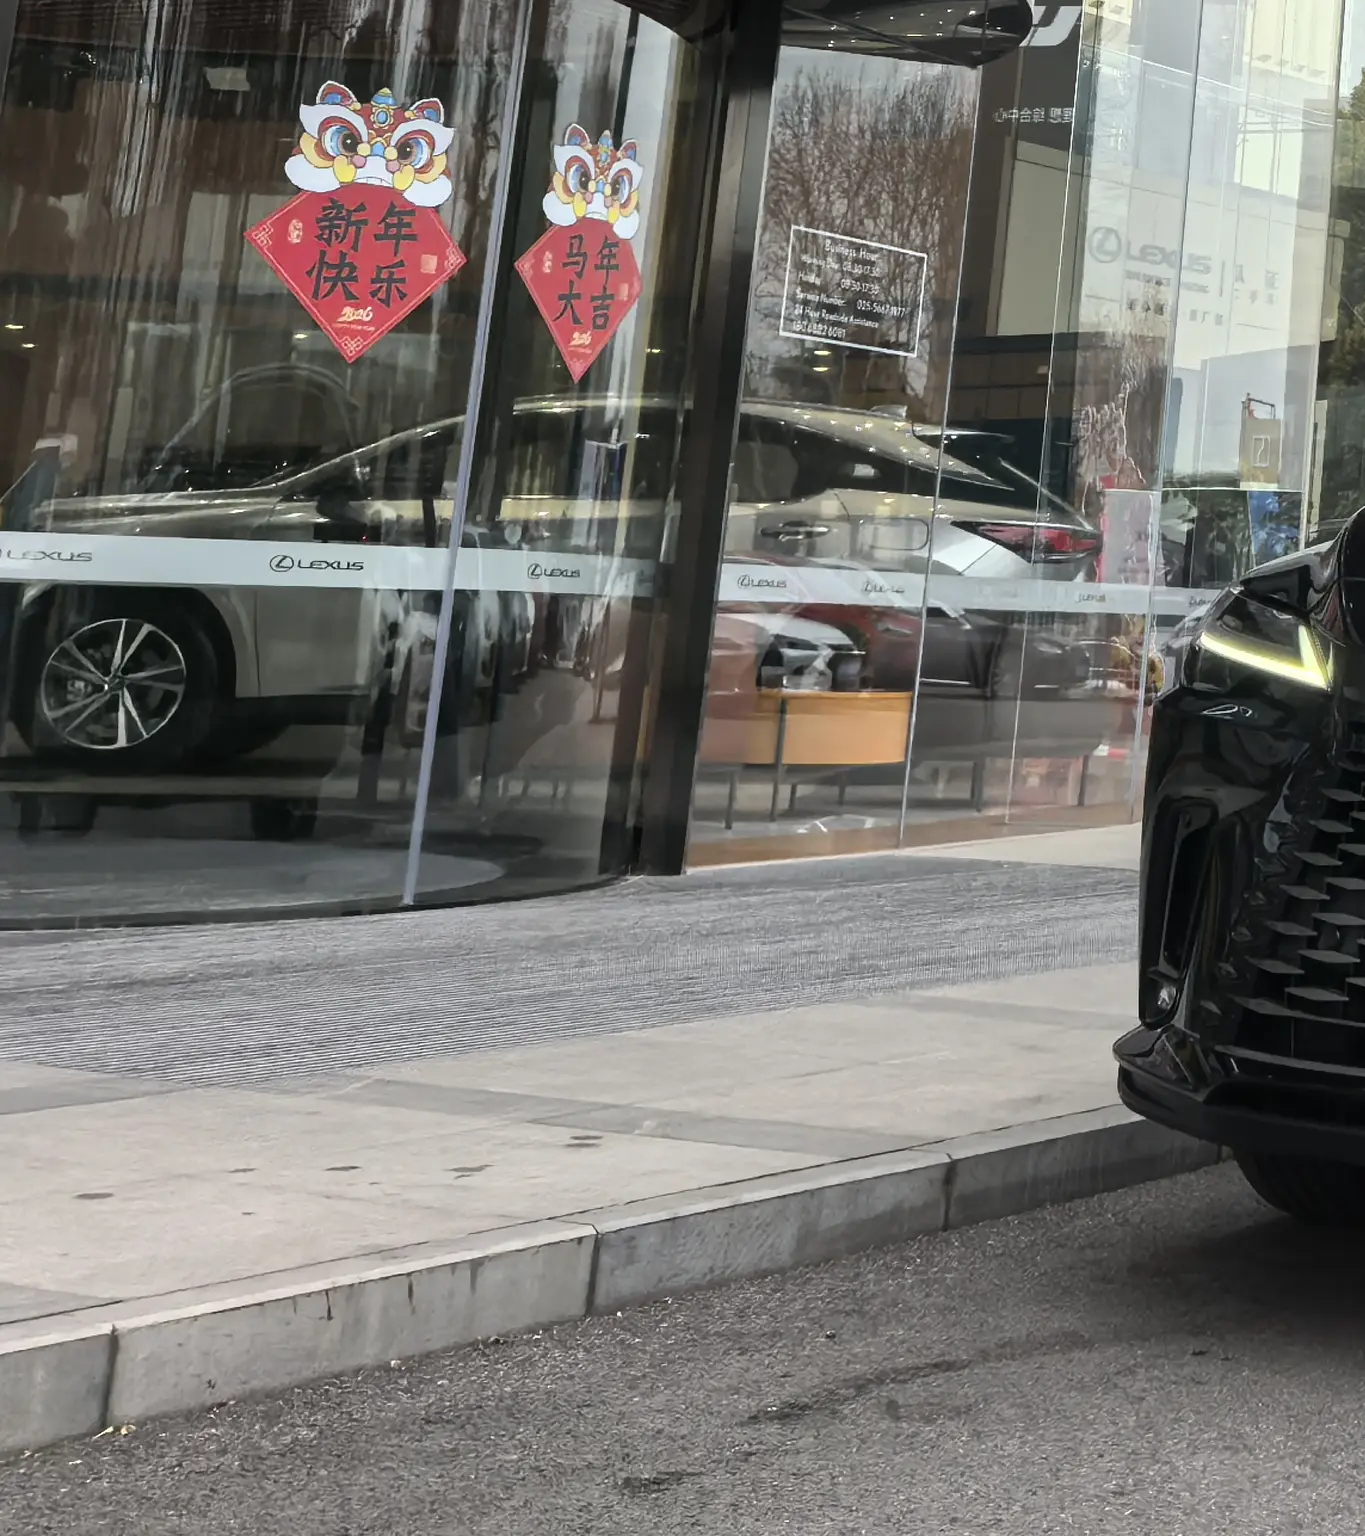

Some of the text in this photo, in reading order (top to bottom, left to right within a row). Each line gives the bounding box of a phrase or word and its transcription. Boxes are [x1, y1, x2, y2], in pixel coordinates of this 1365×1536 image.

[315, 197, 419, 257] 新年
[305, 250, 408, 308] 快乐
[562, 234, 620, 284] 马年
[337, 306, 374, 322] 2026
[552, 279, 615, 329] 大吉
[7, 550, 93, 563] LEXUS
[297, 559, 365, 571] LEXUS
